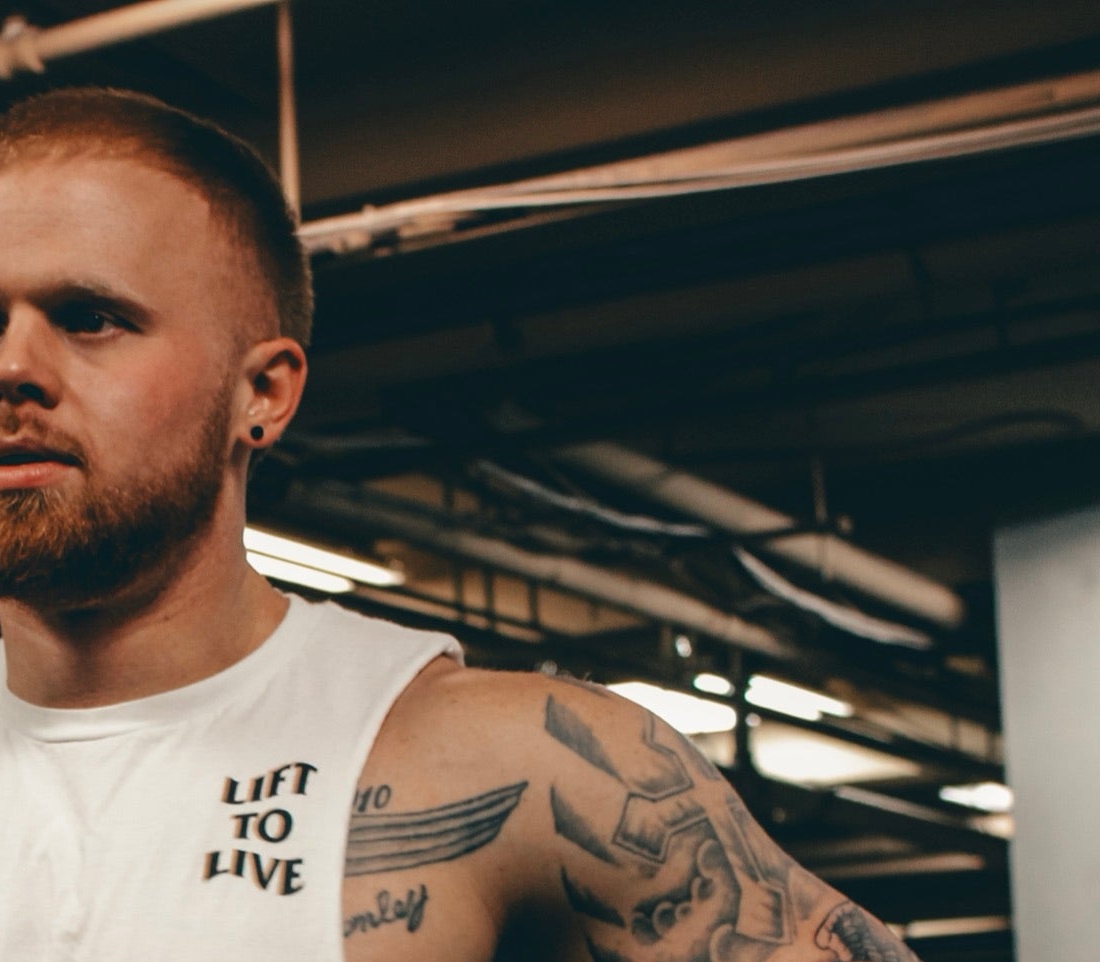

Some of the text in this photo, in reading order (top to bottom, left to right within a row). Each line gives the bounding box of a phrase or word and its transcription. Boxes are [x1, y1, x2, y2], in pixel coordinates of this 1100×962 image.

[220, 762, 318, 805] LIFT
[231, 808, 293, 843] TO
[202, 849, 305, 896] LIVE
